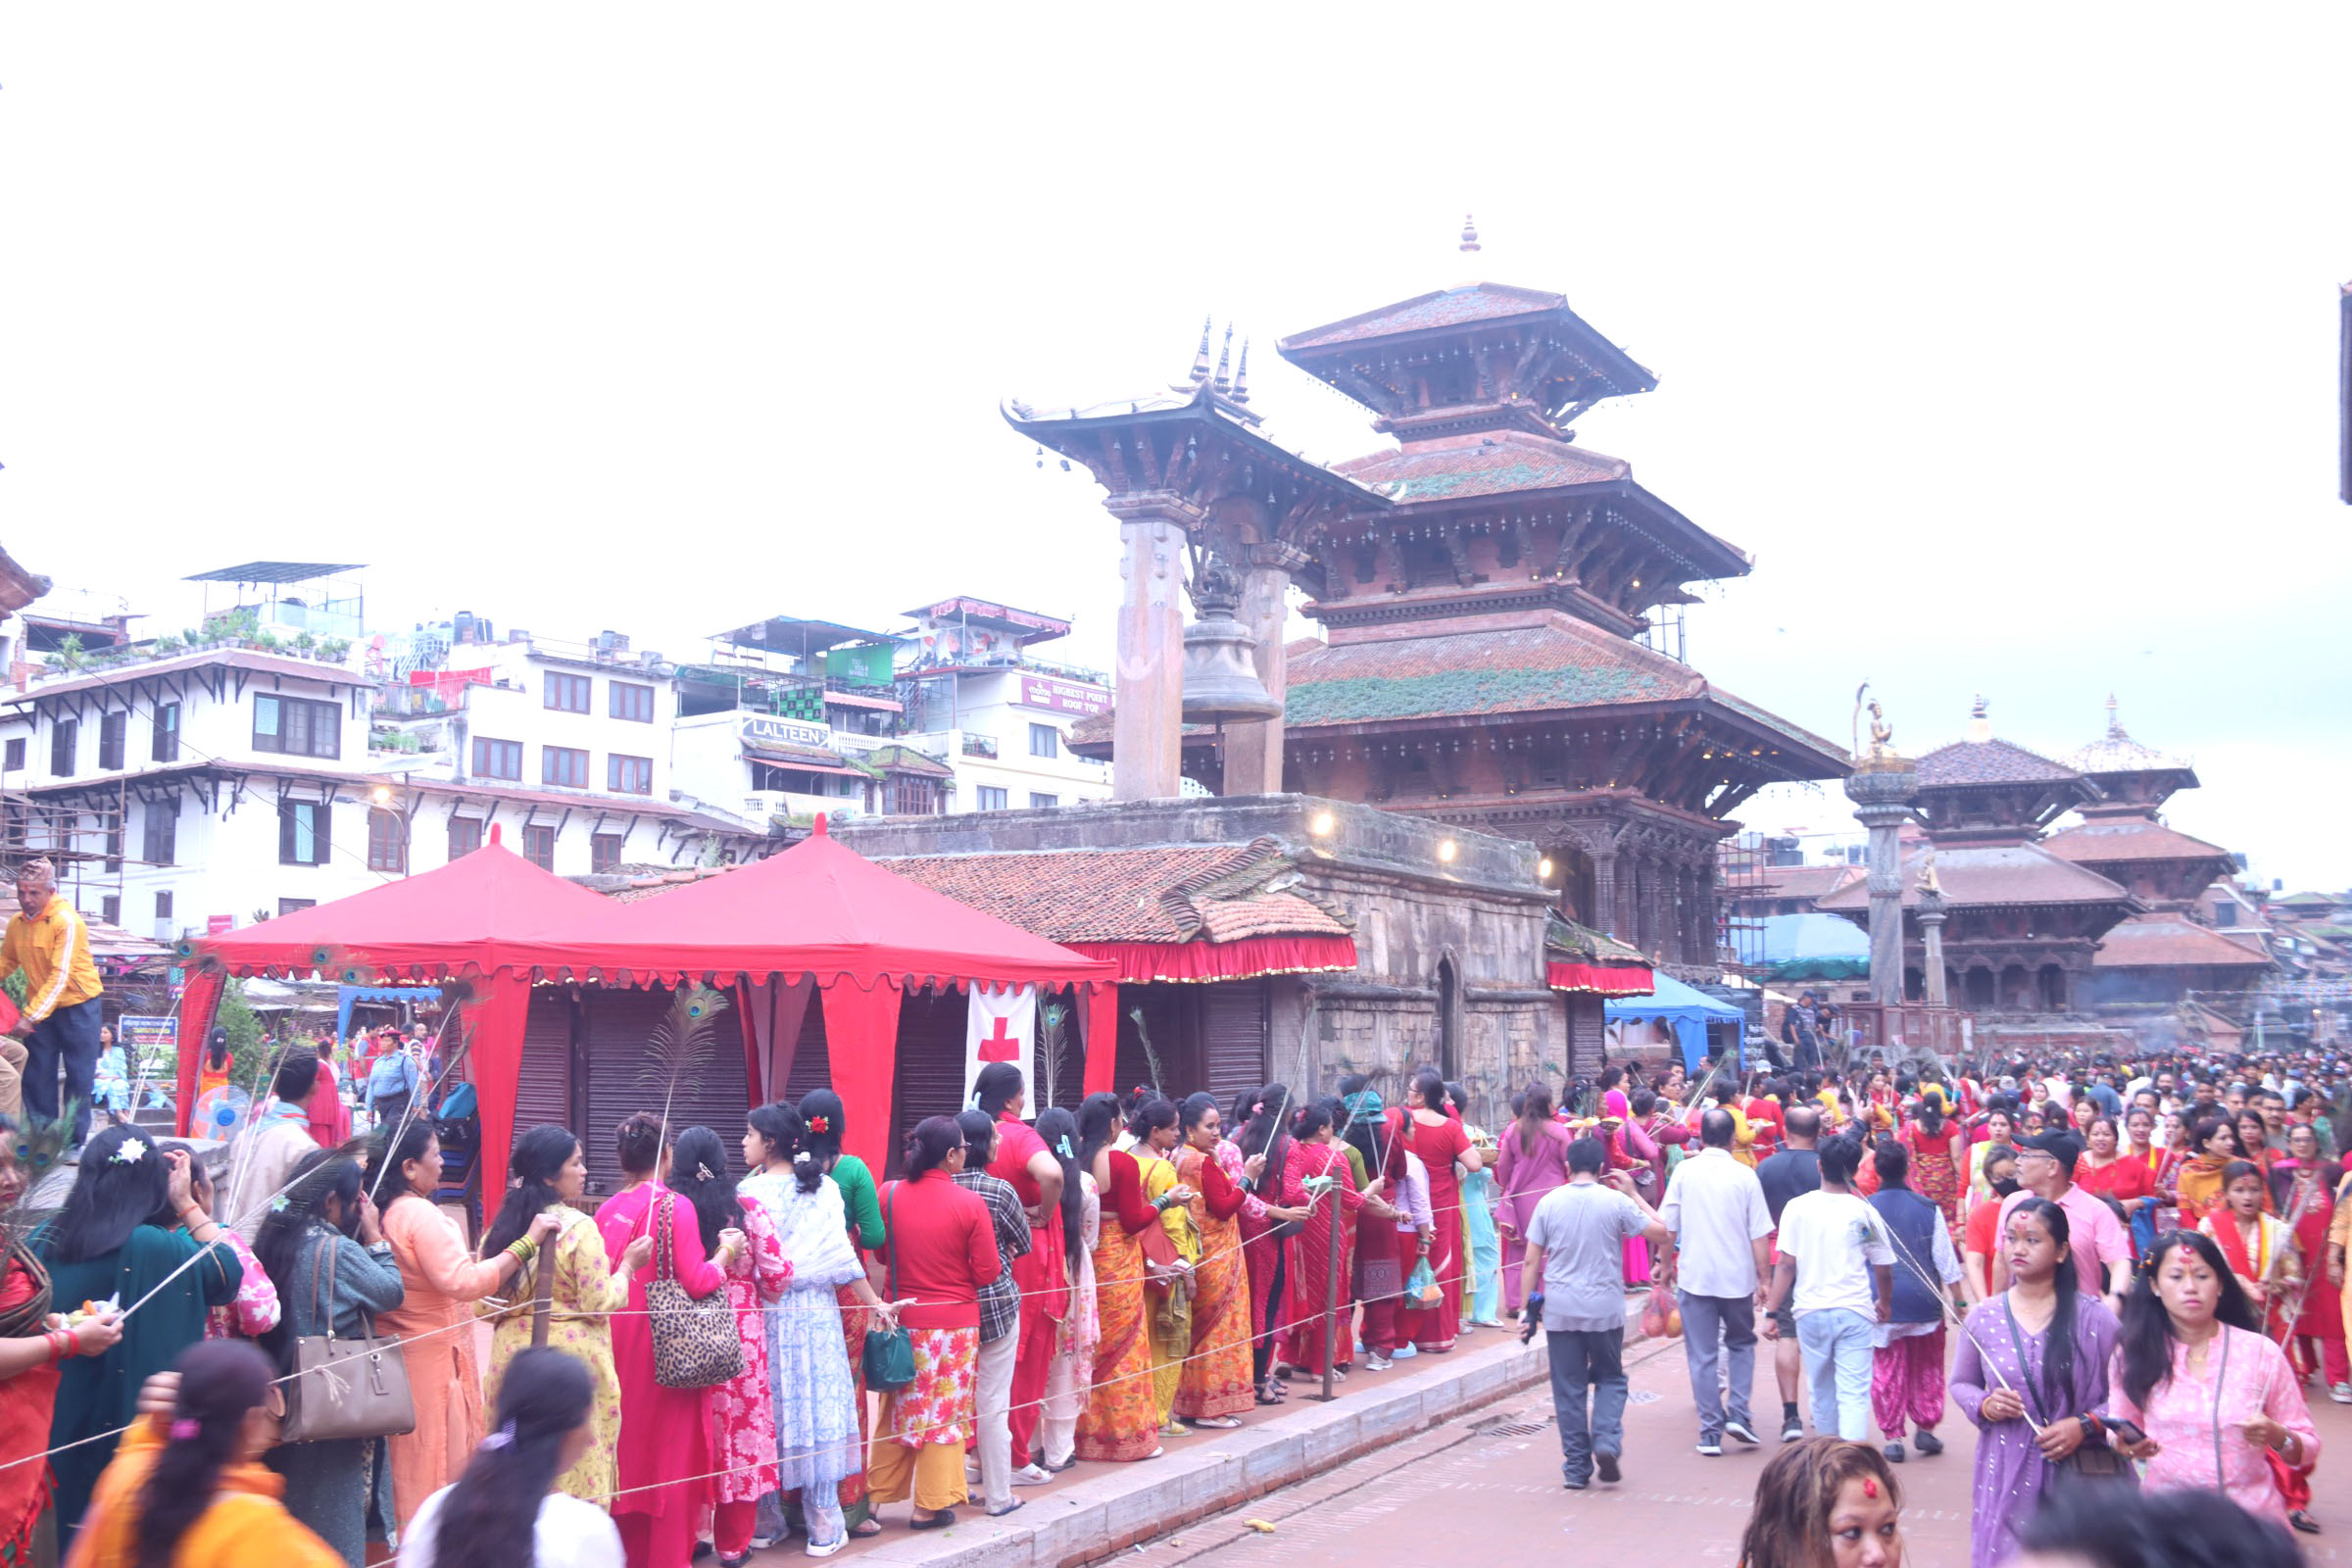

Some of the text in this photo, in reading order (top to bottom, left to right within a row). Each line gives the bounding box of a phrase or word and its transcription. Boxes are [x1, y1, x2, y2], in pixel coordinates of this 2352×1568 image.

[1053, 685, 1084, 699] HIGHEST
[1086, 692, 1107, 704] POINT
[1062, 699, 1083, 710] ROOF
[1084, 704, 1099, 713] TOP
[753, 720, 819, 744] LALTEEN
